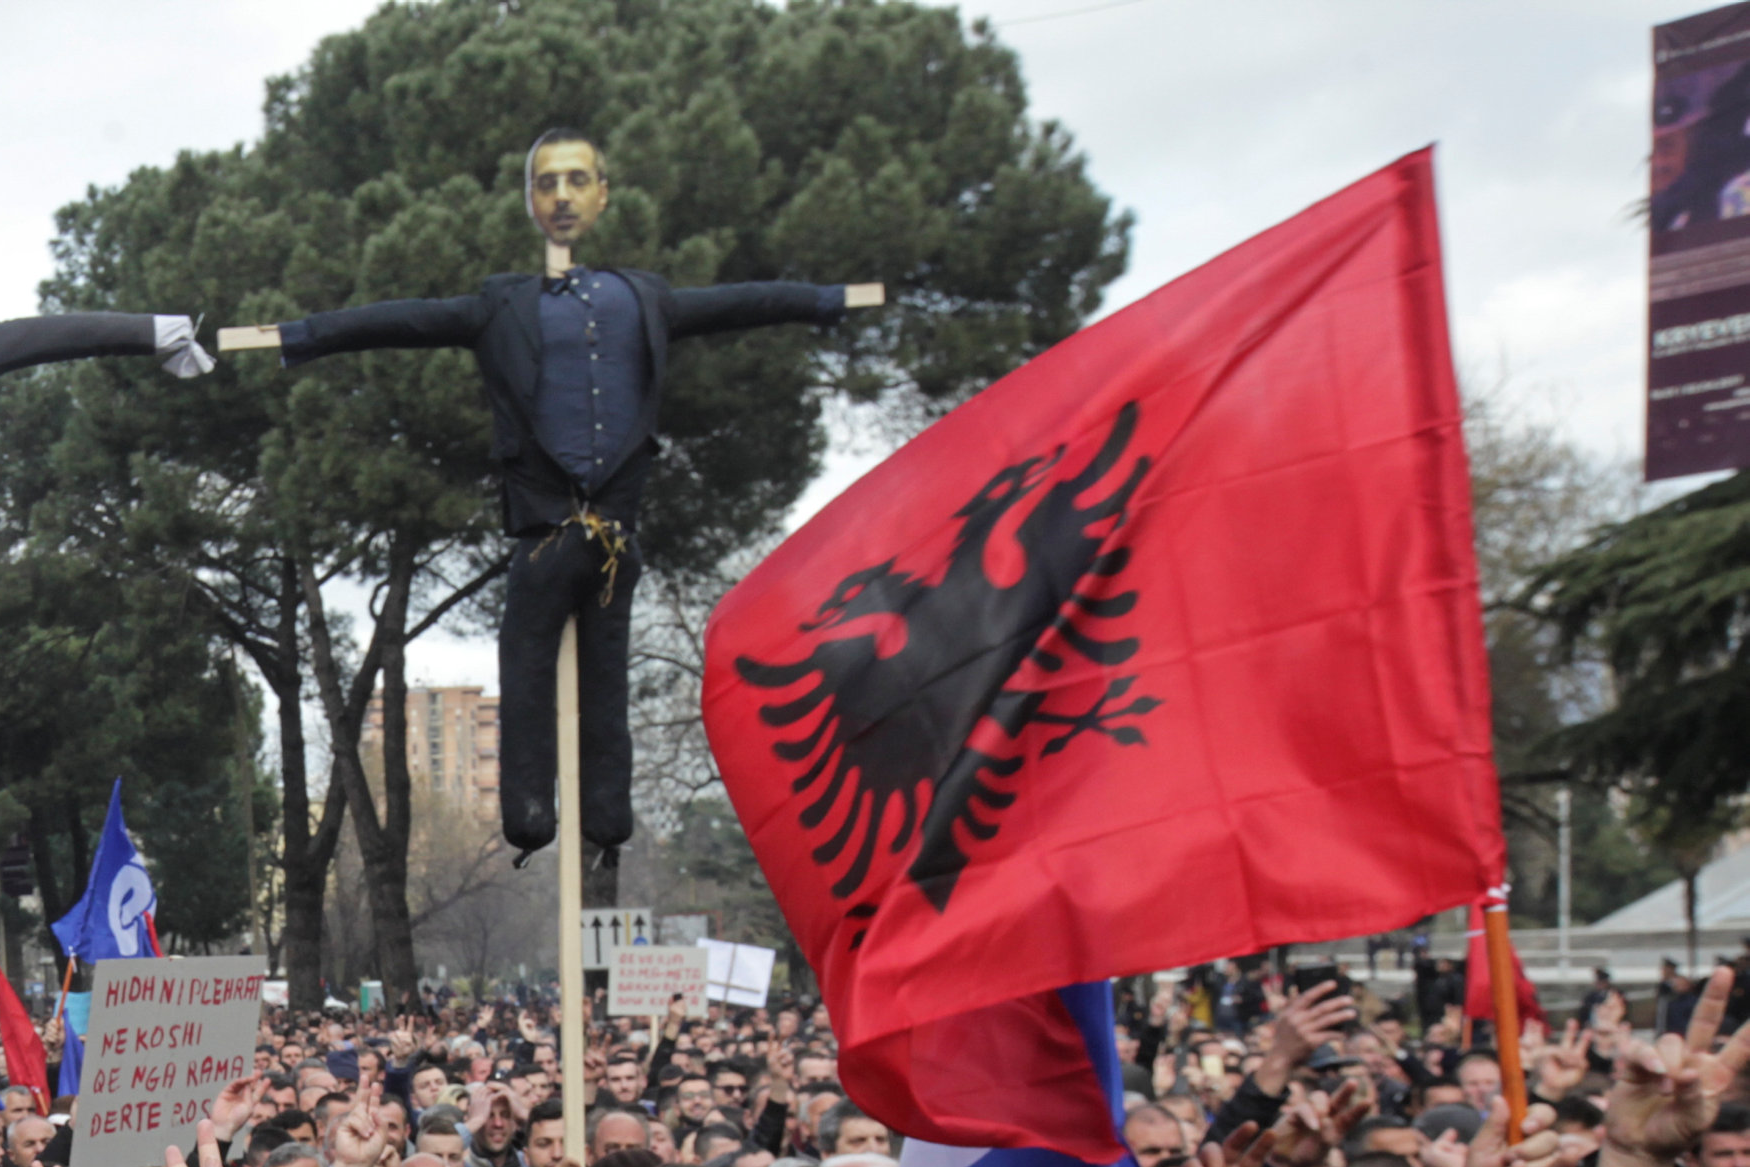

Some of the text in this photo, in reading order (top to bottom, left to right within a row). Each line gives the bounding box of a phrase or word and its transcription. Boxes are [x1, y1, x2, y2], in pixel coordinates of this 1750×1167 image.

[101, 1022, 203, 1057] NE KOSHI
[131, 1062, 176, 1092] NGA
[186, 1055, 245, 1088] RAMA
[90, 1101, 162, 1138] DERTE
